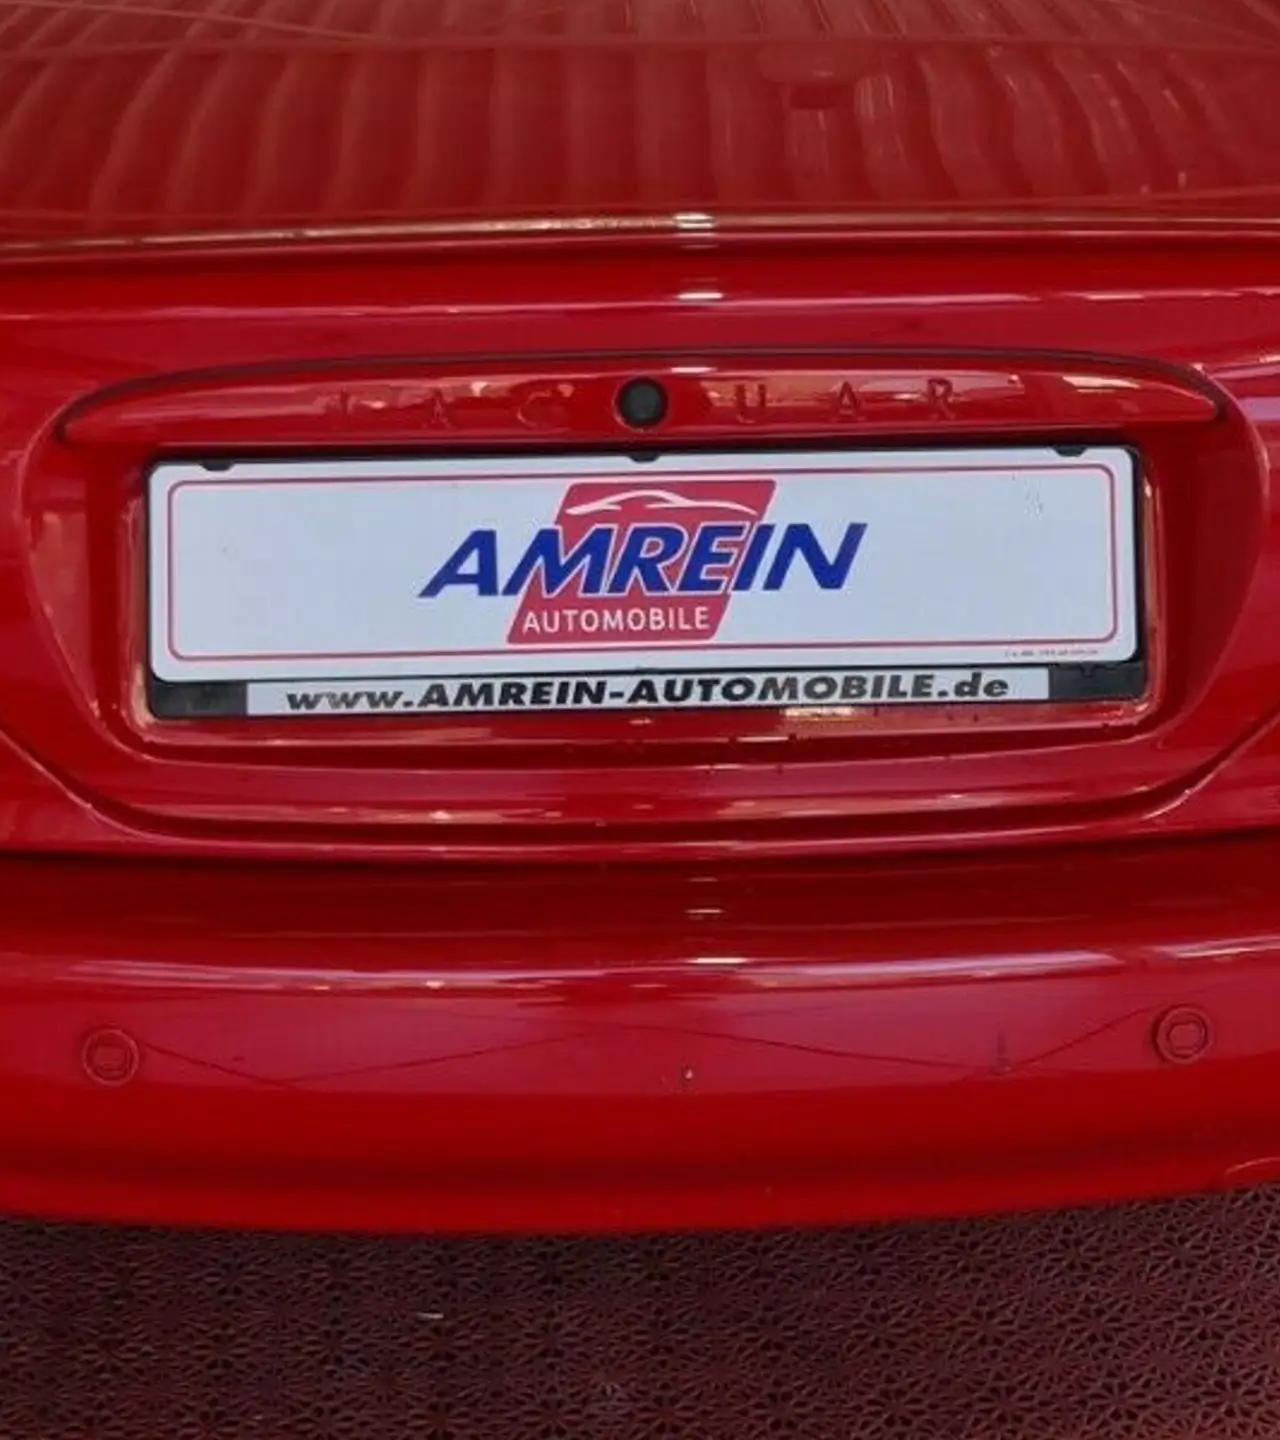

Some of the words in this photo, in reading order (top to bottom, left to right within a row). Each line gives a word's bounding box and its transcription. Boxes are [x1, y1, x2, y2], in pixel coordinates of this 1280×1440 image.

[418, 521, 869, 598] AMREIN
[522, 605, 711, 635] AUTOMOBILE
[285, 671, 1010, 711] www.AMREIN-AUTOMOBILE.de
